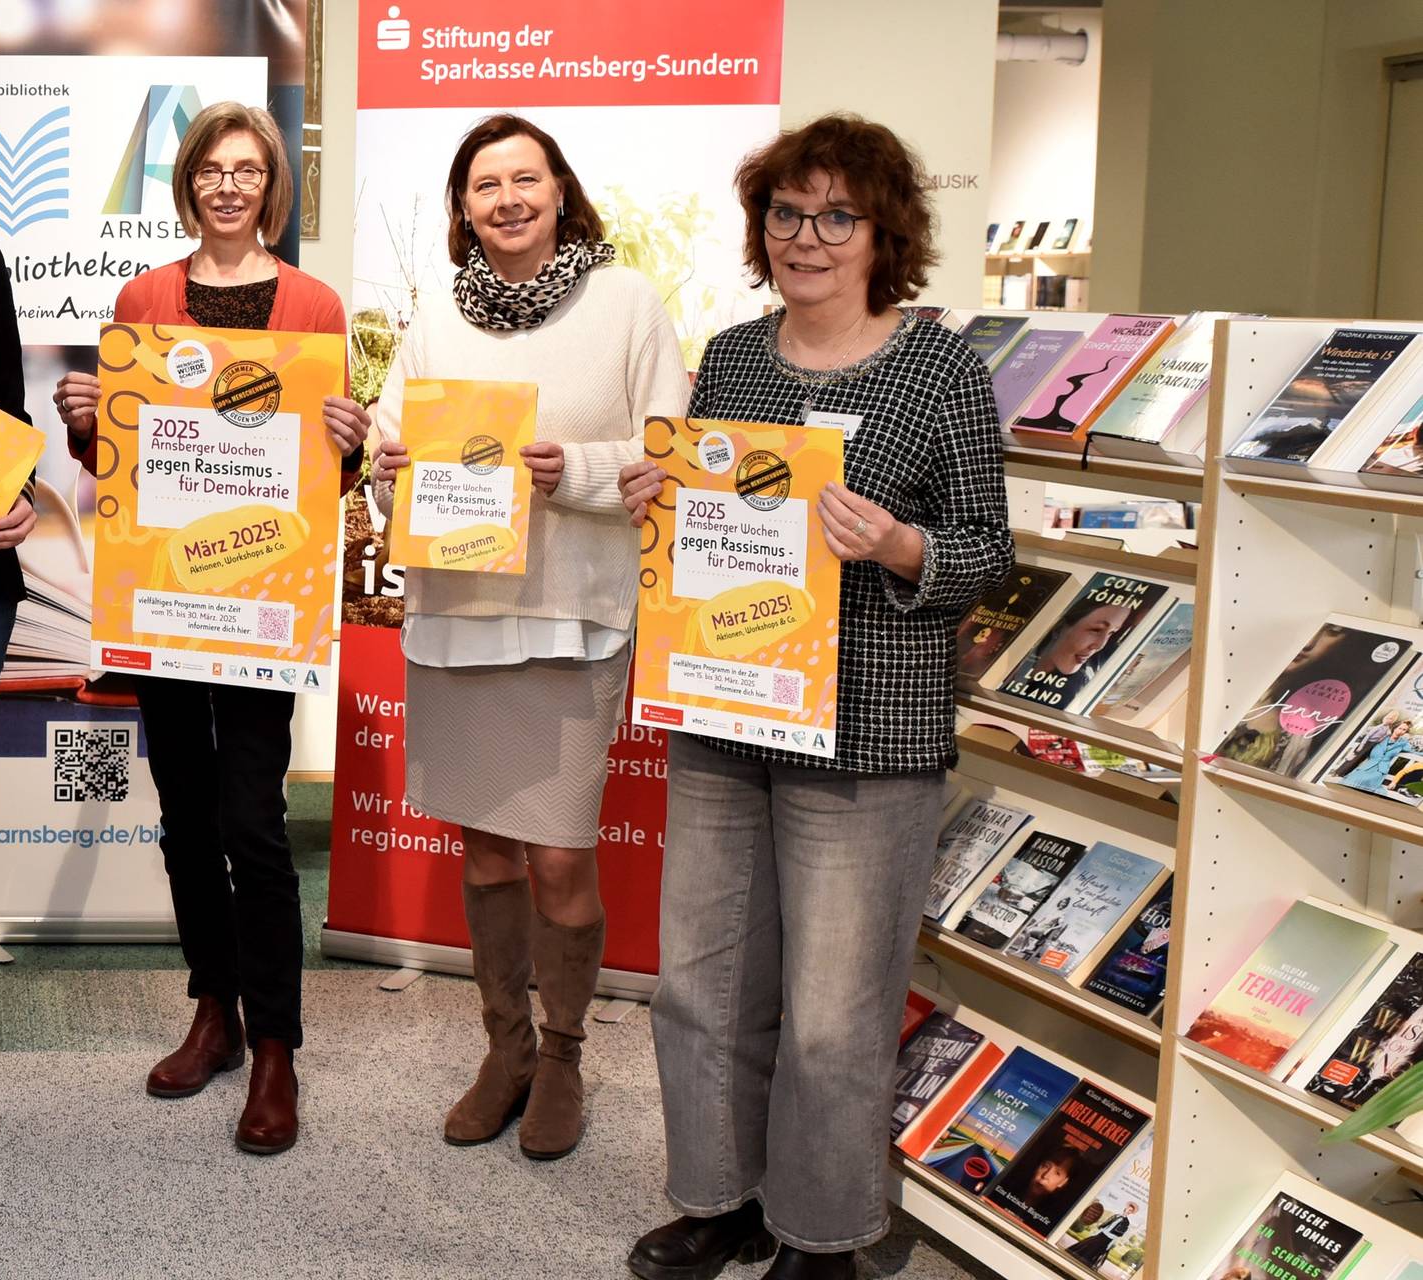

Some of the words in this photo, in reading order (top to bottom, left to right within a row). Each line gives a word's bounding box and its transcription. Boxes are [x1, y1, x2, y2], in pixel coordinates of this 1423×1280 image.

[422, 26, 511, 52] Stiftung
[515, 25, 554, 48] der
[421, 57, 536, 85] Sparkasse
[539, 54, 759, 83] Arnsberg-Sundern
[1110, 327, 1155, 337] NICHOLLS
[1134, 320, 1162, 329] DAVID
[1337, 331, 1367, 339] THOMAS
[1379, 350, 1395, 360] 15
[223, 365, 254, 384] ZUSAMMEN
[1158, 358, 1209, 373] HARUKI
[1135, 373, 1209, 391] MURAKAMI
[152, 418, 200, 440] 2025
[151, 437, 215, 456] Arnsberger
[218, 442, 266, 457] Wochen
[146, 459, 190, 475] gegen
[195, 459, 272, 478] Rassismus
[421, 469, 452, 483] 2025
[179, 474, 199, 492] für
[204, 478, 290, 500] Demokratie
[420, 482, 461, 492] Arnsberger
[462, 483, 492, 493] Wochen
[416, 493, 445, 504] gegen
[447, 493, 496, 506] Rassismus
[437, 504, 450, 515] für
[452, 505, 506, 519] Demokratie
[687, 500, 725, 520] 2025
[685, 518, 738, 536] Arnsberger
[741, 524, 779, 538] Wochen
[184, 539, 227, 562] März
[229, 519, 282, 550] 2025!
[440, 534, 496, 557] Programm
[681, 536, 717, 552] gegen
[721, 536, 785, 557] Rassismus
[189, 561, 224, 575] Aktionen,
[224, 547, 264, 566] Workshops
[275, 541, 287, 551] Co.
[708, 553, 724, 568] für
[728, 555, 799, 577] Demokratie
[1104, 576, 1150, 595] COLM
[138, 597, 173, 608] vielfältiges
[174, 599, 207, 611] Programm
[208, 602, 215, 611] in
[216, 602, 227, 612] der
[228, 605, 241, 613] Zeit
[1086, 588, 1144, 611] TÓIBÍN
[176, 609, 186, 618] bis
[219, 614, 237, 623] 2025
[711, 611, 747, 630] März
[750, 595, 793, 620] 2025!
[187, 621, 220, 632] informiere
[222, 624, 236, 634] dich
[745, 621, 779, 635] Workshops
[1024, 668, 1068, 688] LONG
[1006, 680, 1063, 706] ISLAND
[1242, 689, 1345, 739] Jenny
[355, 726, 394, 749] der
[352, 791, 393, 816] Wir
[971, 805, 1012, 828] RAGNAR
[351, 827, 464, 857] regionale
[1032, 838, 1071, 858] RAGNAR
[1237, 971, 1315, 1017] TERAFIK
[1021, 1079, 1049, 1098] MICHAEL
[993, 1088, 1028, 1111] NICHT
[978, 1108, 1017, 1133] DIESER
[995, 1103, 1018, 1121] VON
[974, 1121, 1005, 1142] WELT
[1277, 1198, 1330, 1230] TOXISCHE
[1255, 1223, 1276, 1239] EIN
[1295, 1224, 1342, 1254] POMMES
[1271, 1246, 1321, 1278] SCHÖNES
